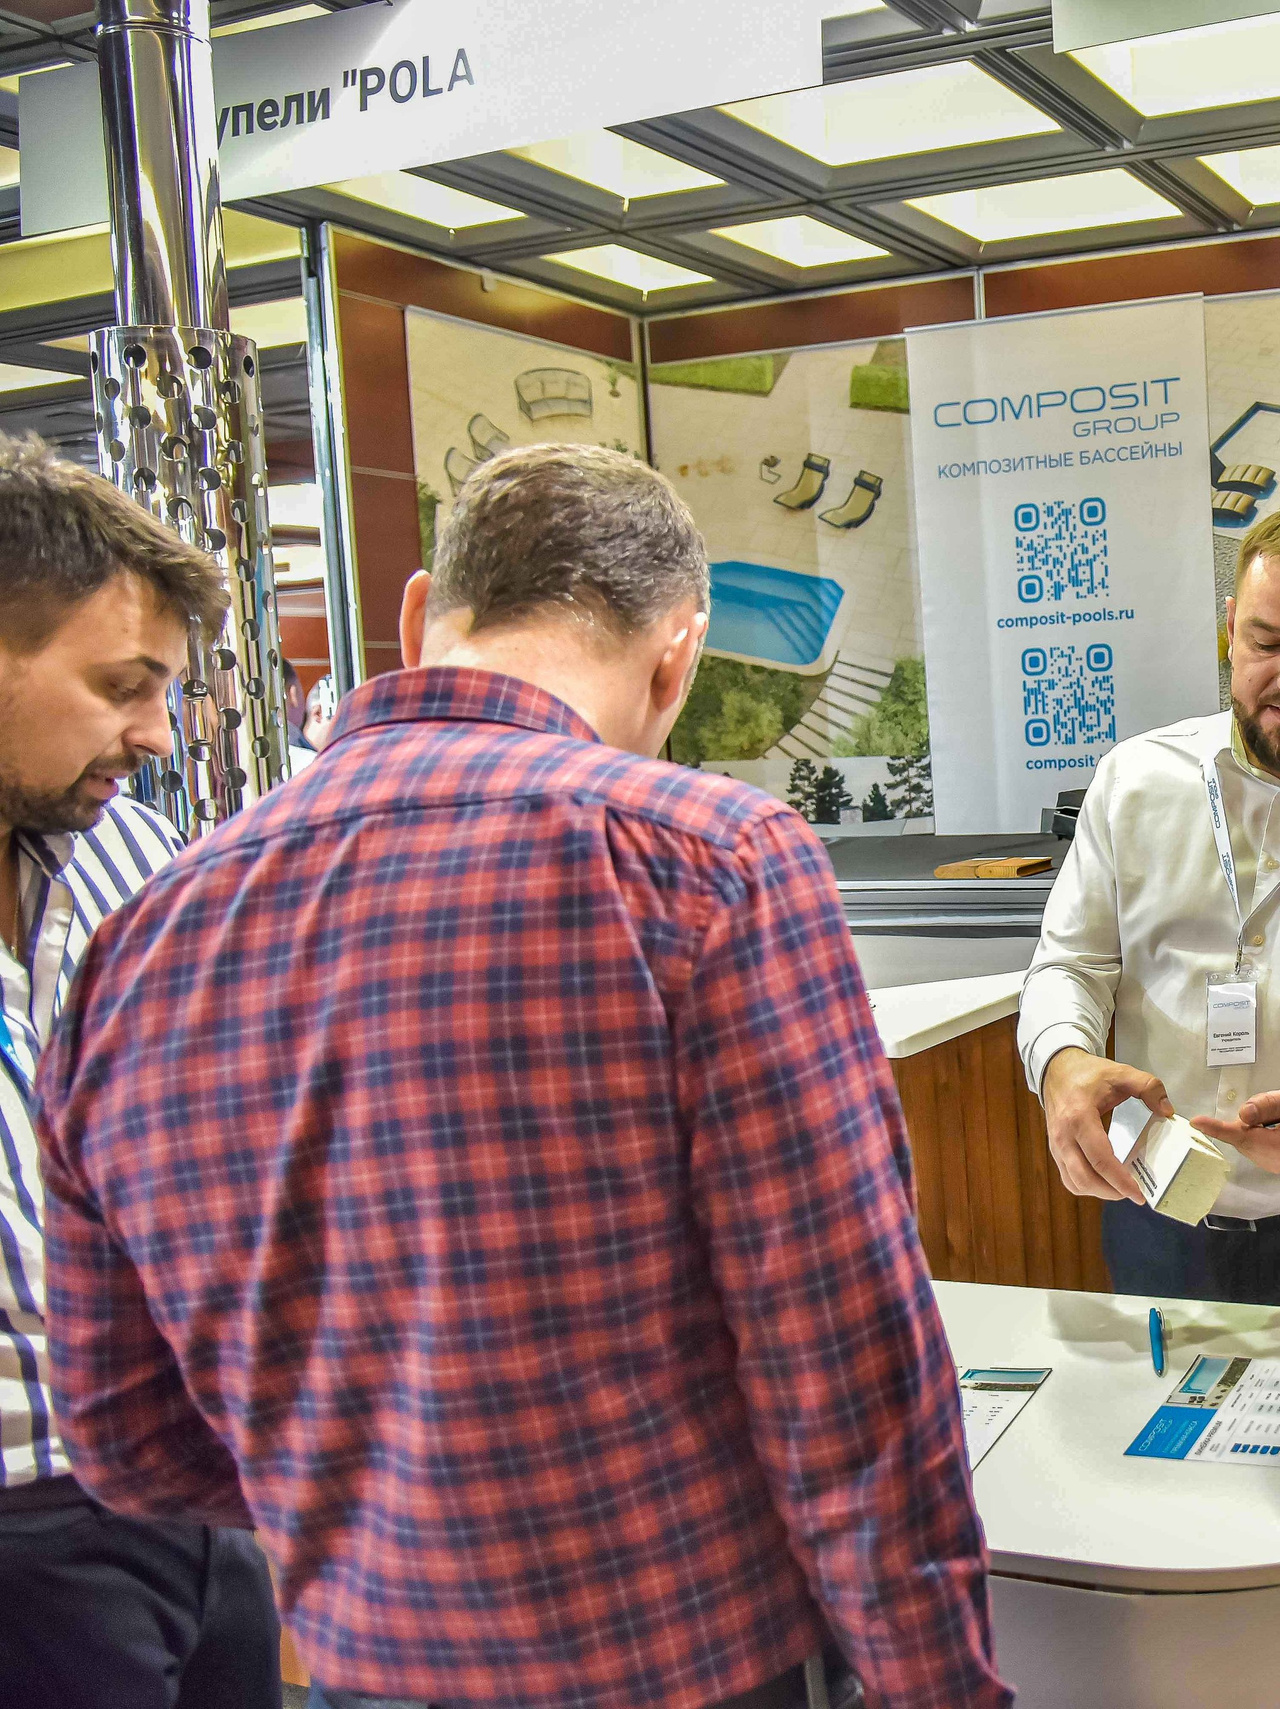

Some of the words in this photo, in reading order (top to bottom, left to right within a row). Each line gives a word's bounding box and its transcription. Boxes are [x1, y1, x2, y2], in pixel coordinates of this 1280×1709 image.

[217, 87, 331, 150] упели
[934, 377, 1181, 428] COMPOSIT
[1072, 412, 1181, 438] GROUP
[937, 451, 1074, 479] КОМПОЗИТНЫЕ
[1079, 441, 1183, 466] БАССЕЙНЫ
[997, 608, 1135, 629] composit-pools.ru
[1206, 780, 1221, 829] COMPOSIT
